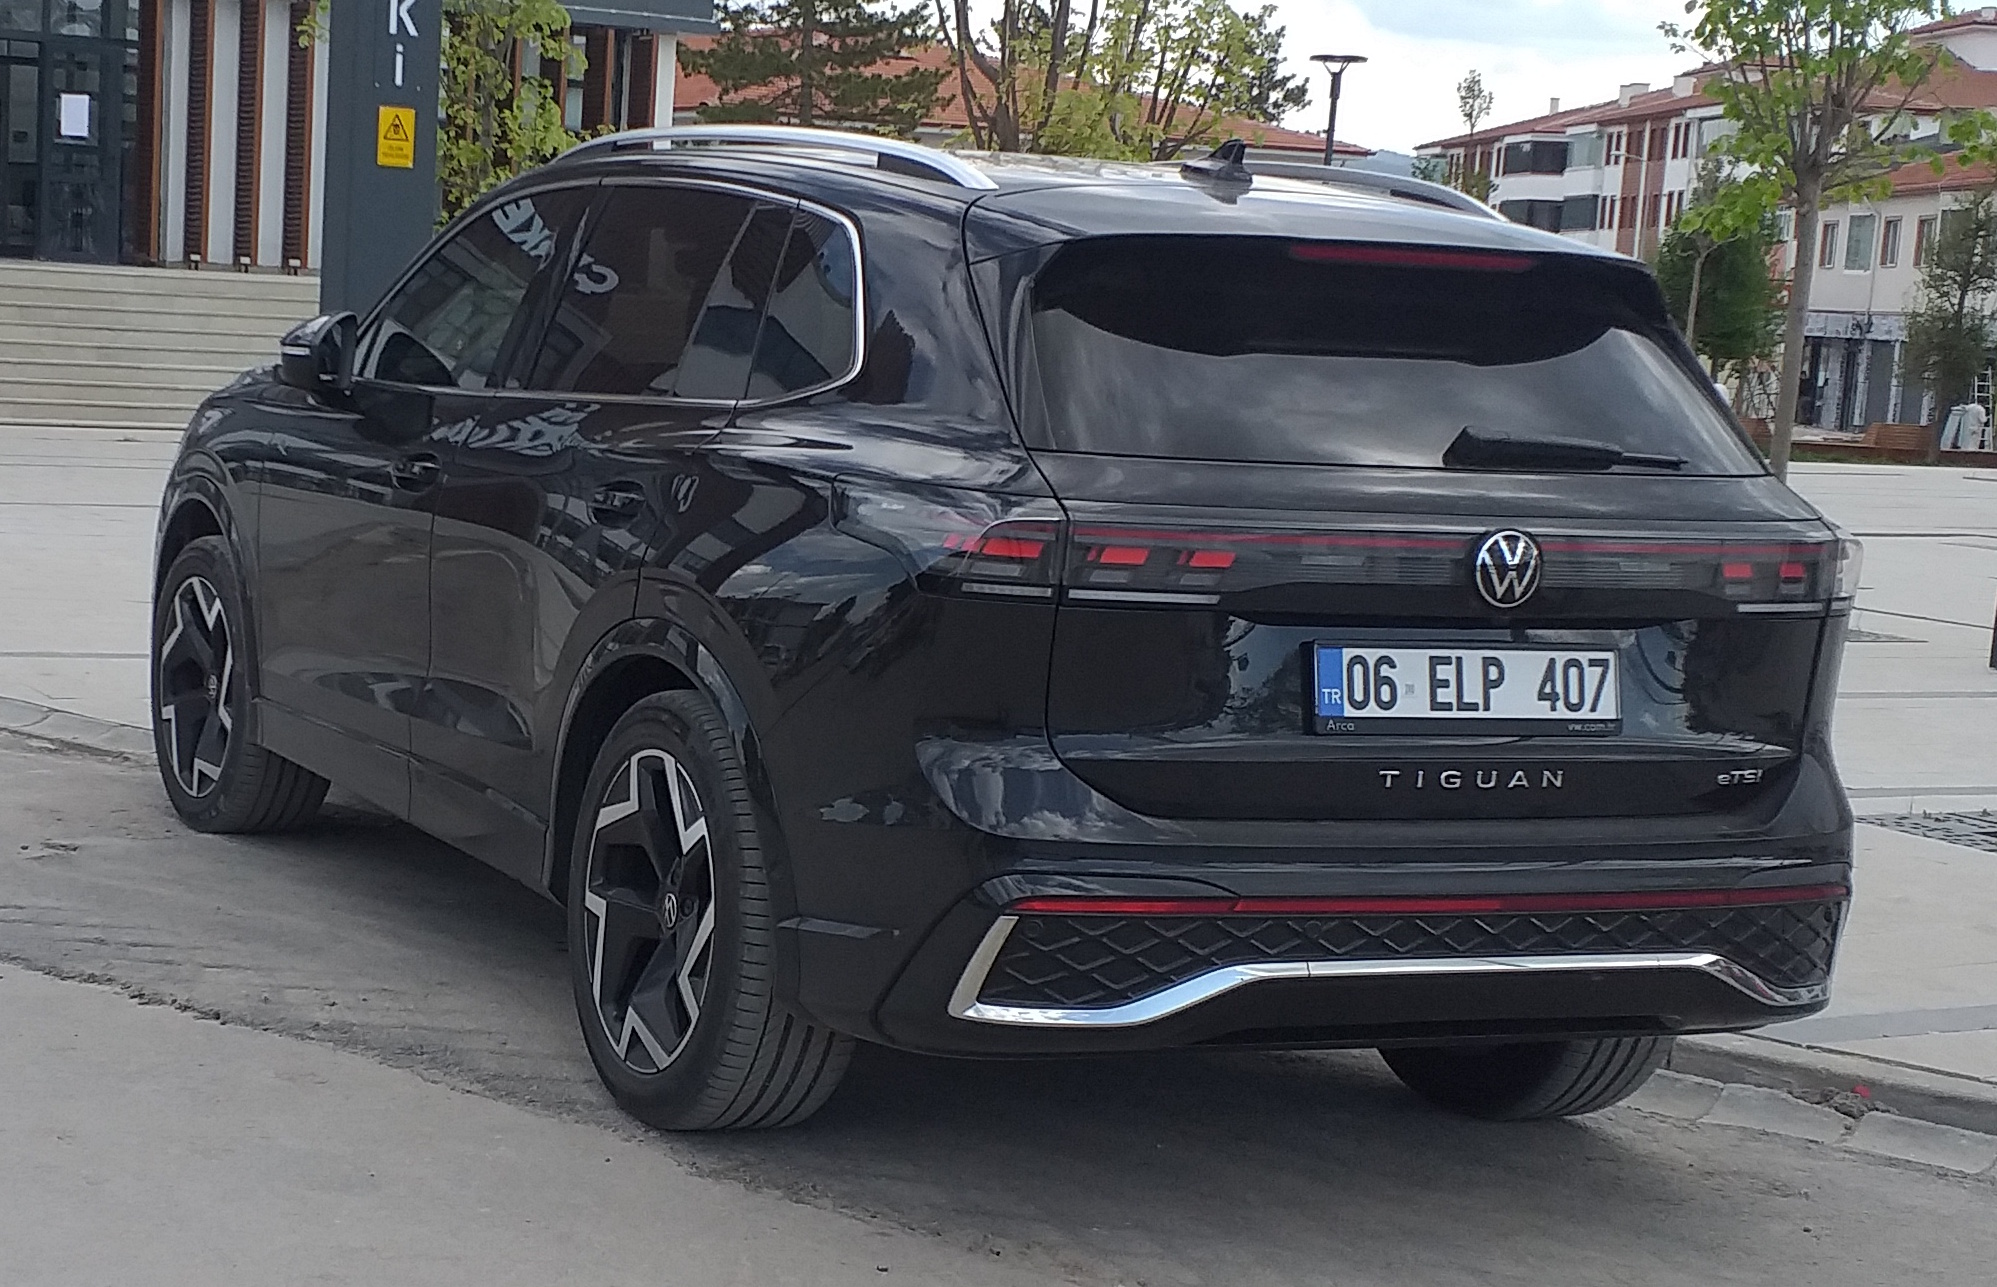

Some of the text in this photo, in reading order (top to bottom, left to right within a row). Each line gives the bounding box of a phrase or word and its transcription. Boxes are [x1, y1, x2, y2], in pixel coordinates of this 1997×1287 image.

[1477, 532, 1538, 606] VW
[1346, 654, 1610, 713] 06 ELP 407
[1321, 688, 1342, 705] TR
[1326, 719, 1355, 731] Arca
[1379, 770, 1564, 789] TIGUAN
[1717, 769, 1764, 785] eTSI
